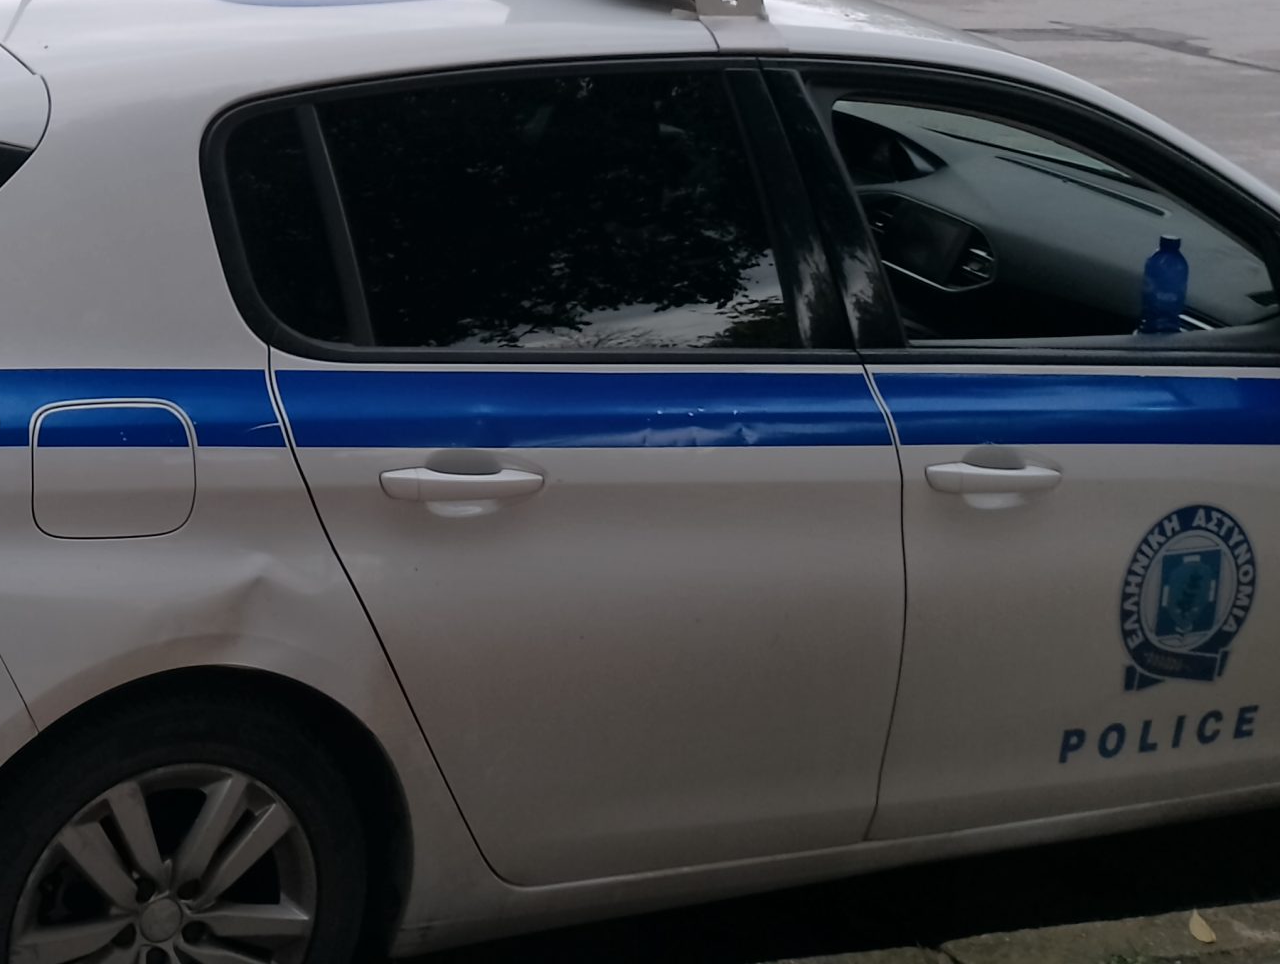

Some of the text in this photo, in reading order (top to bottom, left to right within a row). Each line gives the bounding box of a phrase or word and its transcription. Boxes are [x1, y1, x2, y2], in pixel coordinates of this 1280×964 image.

[1122, 507, 1255, 651] ΕΛΛΗΝΙΚΗ ΑΣΤΥΝΟΜΙΑ
[1058, 704, 1260, 764] POLICE
